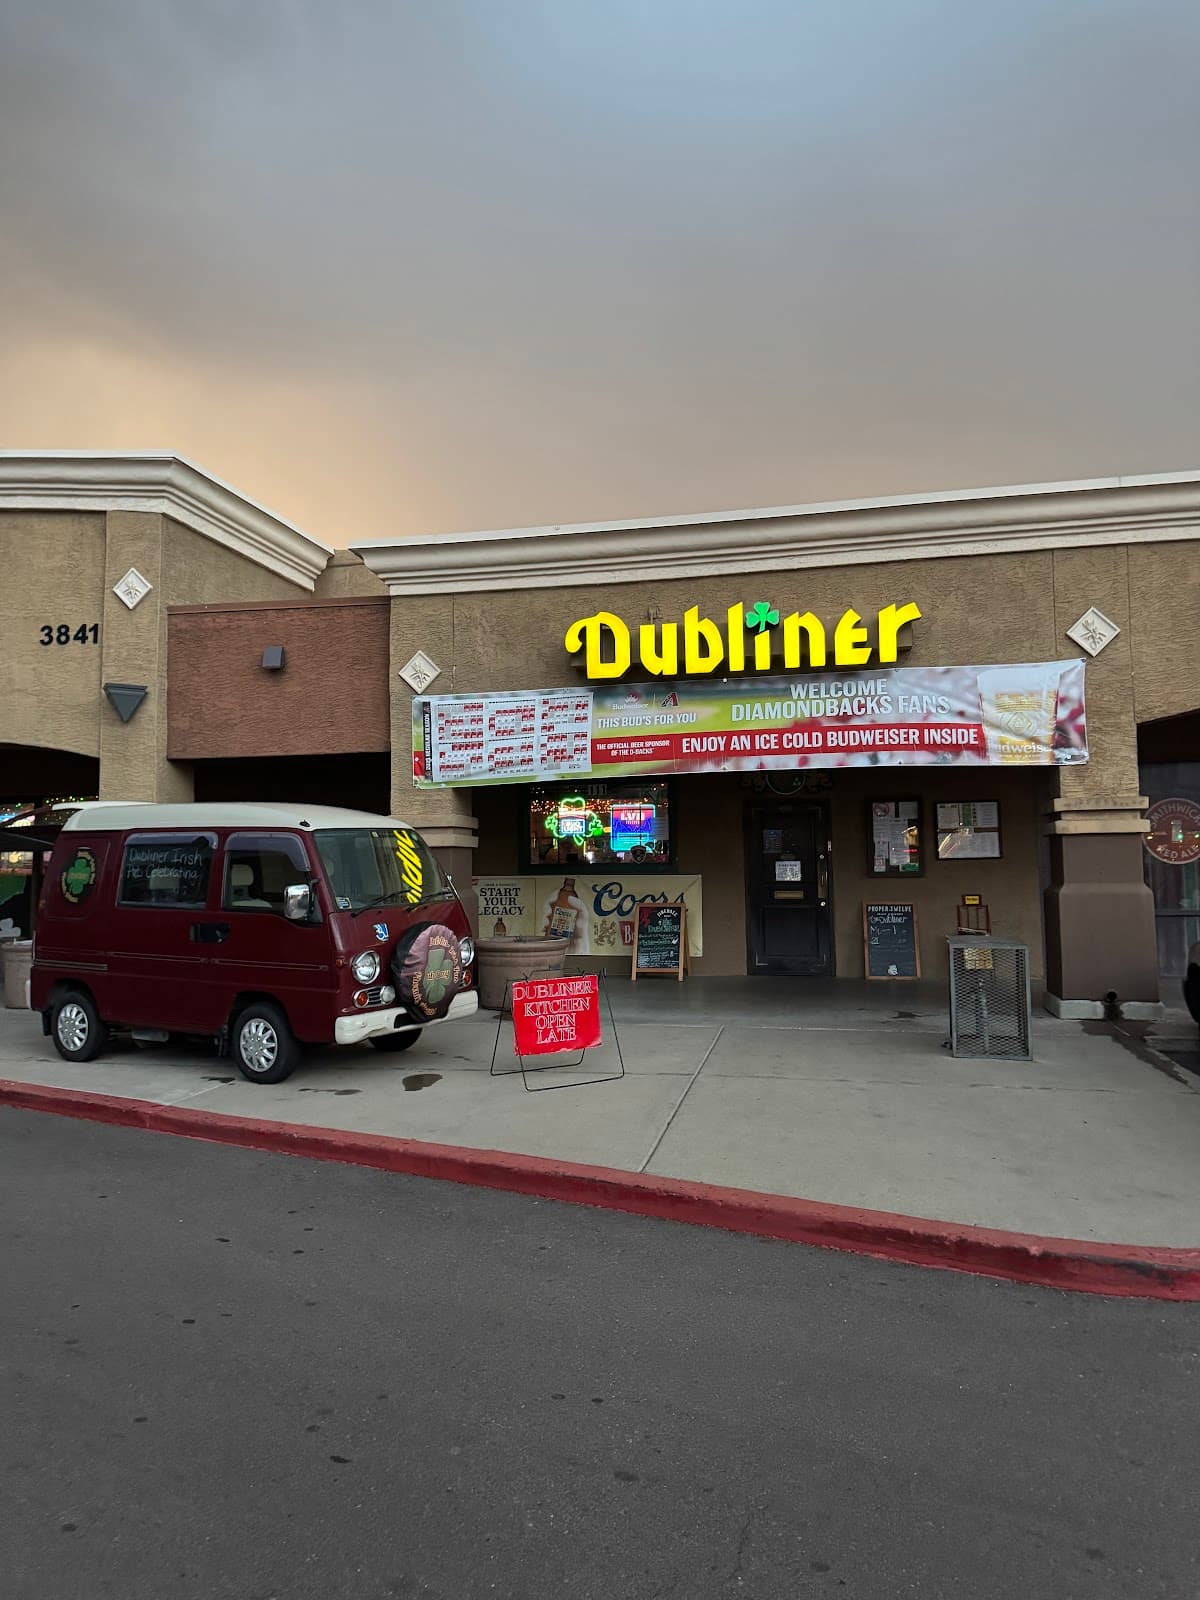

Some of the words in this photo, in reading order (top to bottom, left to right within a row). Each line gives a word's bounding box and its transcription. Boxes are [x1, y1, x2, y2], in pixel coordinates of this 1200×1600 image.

[40, 623, 98, 646] 3841
[564, 601, 922, 679] Dubliner
[790, 679, 888, 700] WELCOME
[731, 695, 893, 721] DIAMONDBACKS
[898, 695, 950, 714] FANS
[597, 717, 620, 728] THIS
[621, 715, 651, 728] BUD'S
[654, 714, 674, 726] FOR
[676, 713, 697, 724] YOU
[607, 742, 629, 750] OFFICIAL
[645, 740, 670, 748] SPONSOR
[682, 735, 727, 753] ENJOY
[730, 734, 751, 751] AN
[755, 733, 779, 750] ICE
[782, 731, 823, 749] COLD
[827, 729, 920, 747] BUDWEISER
[924, 728, 979, 745] INSIDE
[480, 887, 521, 897] START
[484, 896, 518, 906] YOUR
[512, 981, 594, 1000] DUBLINER
[524, 997, 591, 1017] KITCHEN
[535, 1012, 577, 1029] OPEN
[536, 1026, 577, 1045] LATE
